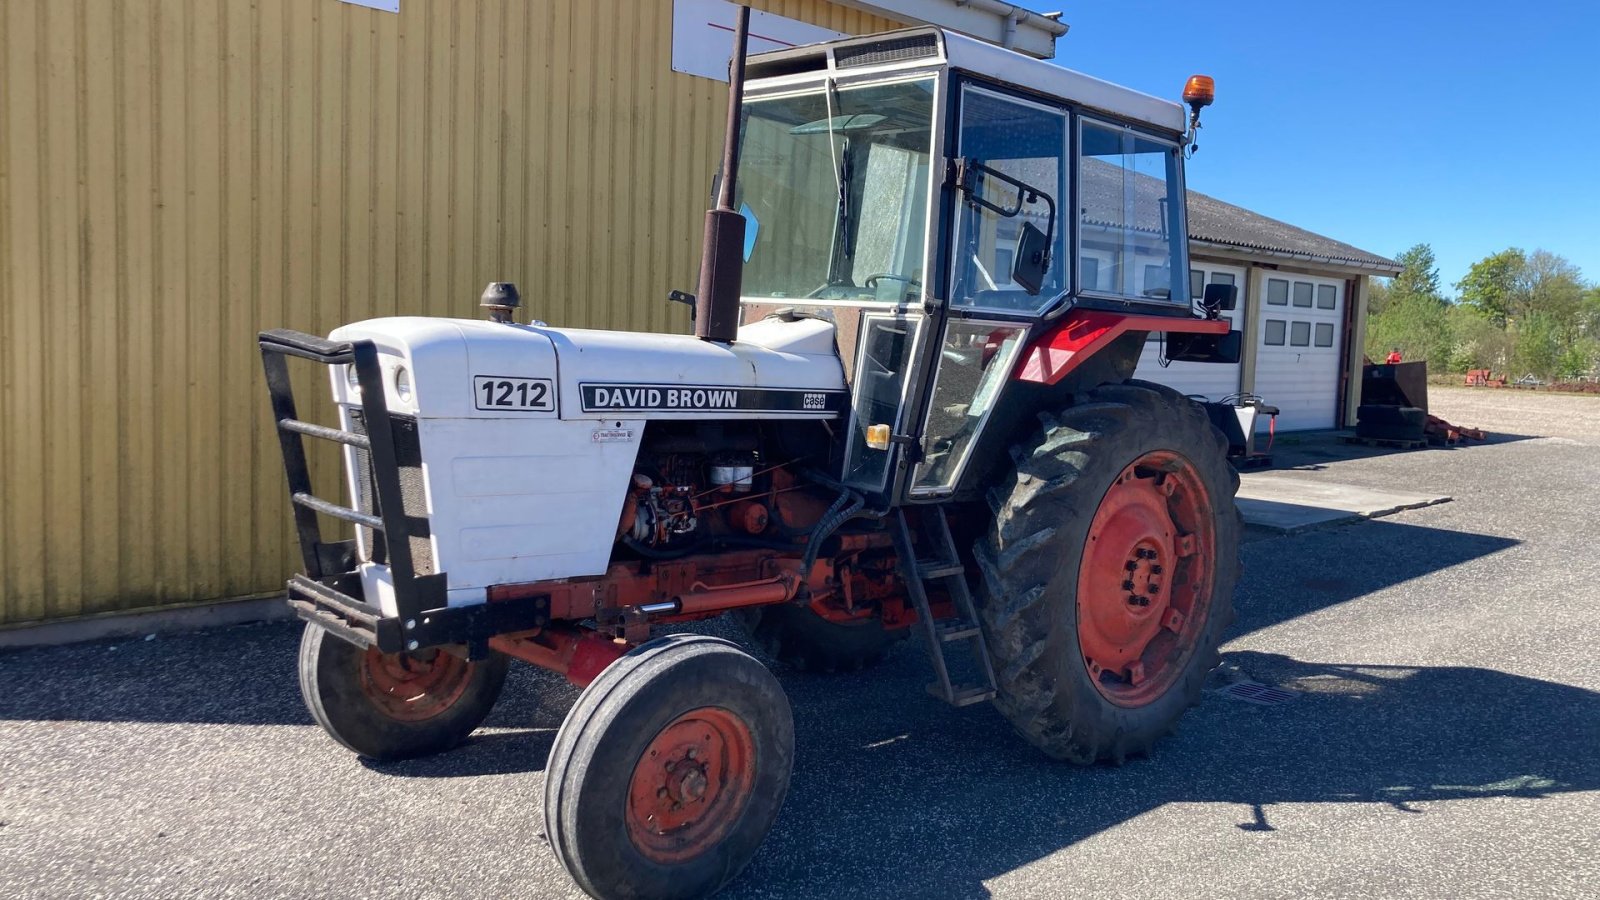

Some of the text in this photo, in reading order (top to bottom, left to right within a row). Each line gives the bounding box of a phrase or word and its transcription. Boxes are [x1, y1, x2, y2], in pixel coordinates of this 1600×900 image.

[482, 381, 547, 407] 1212
[594, 388, 738, 408] DAVID BROWN
